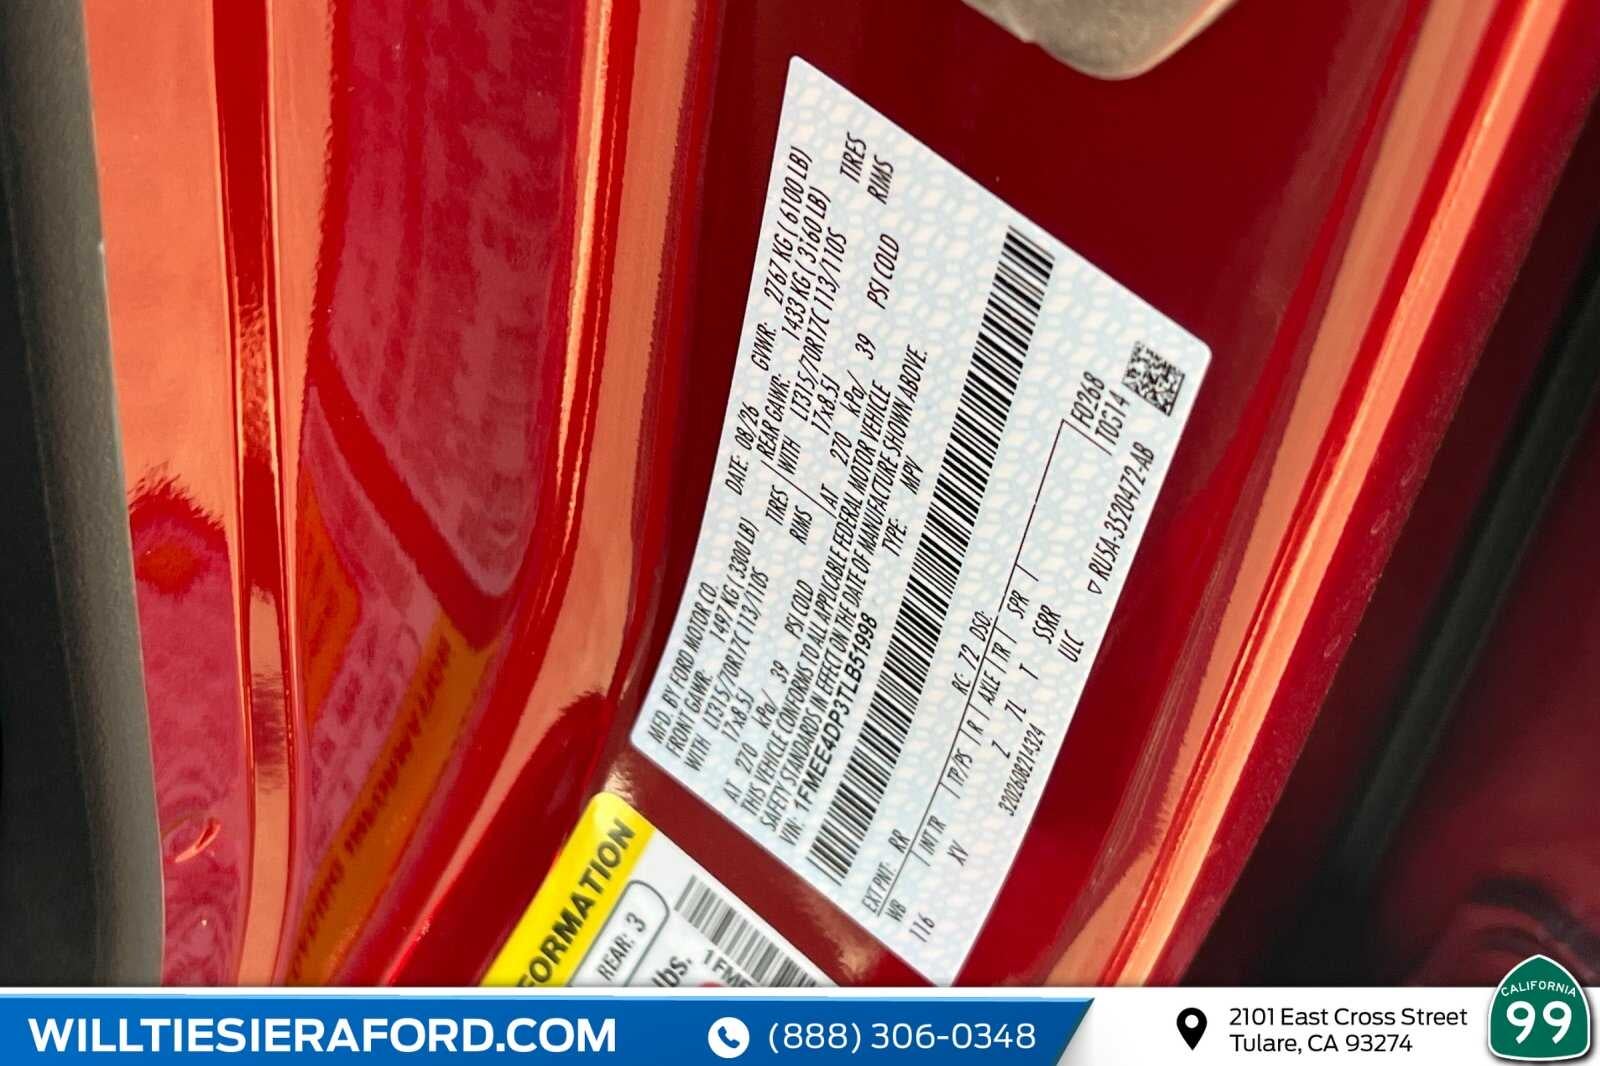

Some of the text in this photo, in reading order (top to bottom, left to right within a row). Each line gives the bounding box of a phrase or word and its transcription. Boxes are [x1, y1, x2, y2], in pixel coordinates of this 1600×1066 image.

[787, 145, 813, 180] LB)
[839, 131, 867, 183] TIRES
[779, 176, 804, 224] 6100
[867, 154, 894, 205] RIMS
[805, 186, 831, 220] LB)
[772, 233, 793, 263] KG
[797, 215, 822, 264] 3160
[764, 258, 788, 306] 2767
[789, 271, 811, 301] KG
[855, 233, 899, 361] 39 PSI COLD
[781, 296, 806, 341] 1433
[789, 226, 847, 422] LT315/70R17C 113/110S
[751, 322, 777, 372] GVWR:
[756, 373, 791, 461] REAR GAWR:
[811, 373, 840, 436] 17x8.5J
[1070, 371, 1105, 429] F0268
[724, 402, 760, 496] DATE: 08/26
[777, 434, 801, 475] WITH
[819, 370, 868, 510] AT 270 kPa/
[765, 484, 789, 526] TIRES
[789, 505, 813, 545] RIMS
[881, 455, 924, 557] TYPE: MPV
[1088, 441, 1154, 581] RU5A-3520472-AB
[737, 516, 759, 545] LB)
[728, 540, 751, 579] 3300
[720, 584, 740, 610] KG
[740, 379, 891, 816] THIS VEHICLE CONFORMS TO ALL APPLICABLE FEDERAL MOTOR VEHICLE
[760, 343, 928, 832] SAFETY STANDARDS IN EFFECT ON THE DATE OF MANUFACTURE SHOWN ABOVE.
[1007, 589, 1030, 620] SPR
[709, 604, 733, 643] 1497
[770, 579, 814, 684] 39 PSI COLD
[1032, 604, 1061, 645] SSRR
[647, 581, 719, 745] MFD. BY FORD MOTOR CO.
[702, 566, 769, 730] LT315/70R17C 113/110S
[958, 643, 980, 671] 72
[991, 642, 1011, 663] TR
[1058, 629, 1084, 663] ULC
[977, 670, 1001, 706] AXLE
[1019, 663, 1038, 680] T
[665, 669, 714, 758] FRONT GAWR:
[721, 687, 755, 743] 17x8.5J
[778, 612, 877, 847] VIN: 1FMEE4DP3TLB51998
[966, 719, 984, 735] R
[1004, 699, 1027, 722] 7L
[684, 733, 711, 772] WITH
[723, 688, 778, 804] AT 270 kPa/
[991, 740, 1011, 759] Z
[947, 748, 973, 786] TP/PS
[998, 723, 1046, 817] 3202608214324
[888, 829, 910, 854] RR
[919, 815, 946, 855] INT TR
[947, 840, 969, 866] XV
[861, 885, 883, 914] EXT
[885, 899, 906, 922] WB
[597, 912, 647, 981] REAR: 3
[909, 913, 935, 943] 116
[651, 955, 692, 987] lbs.
